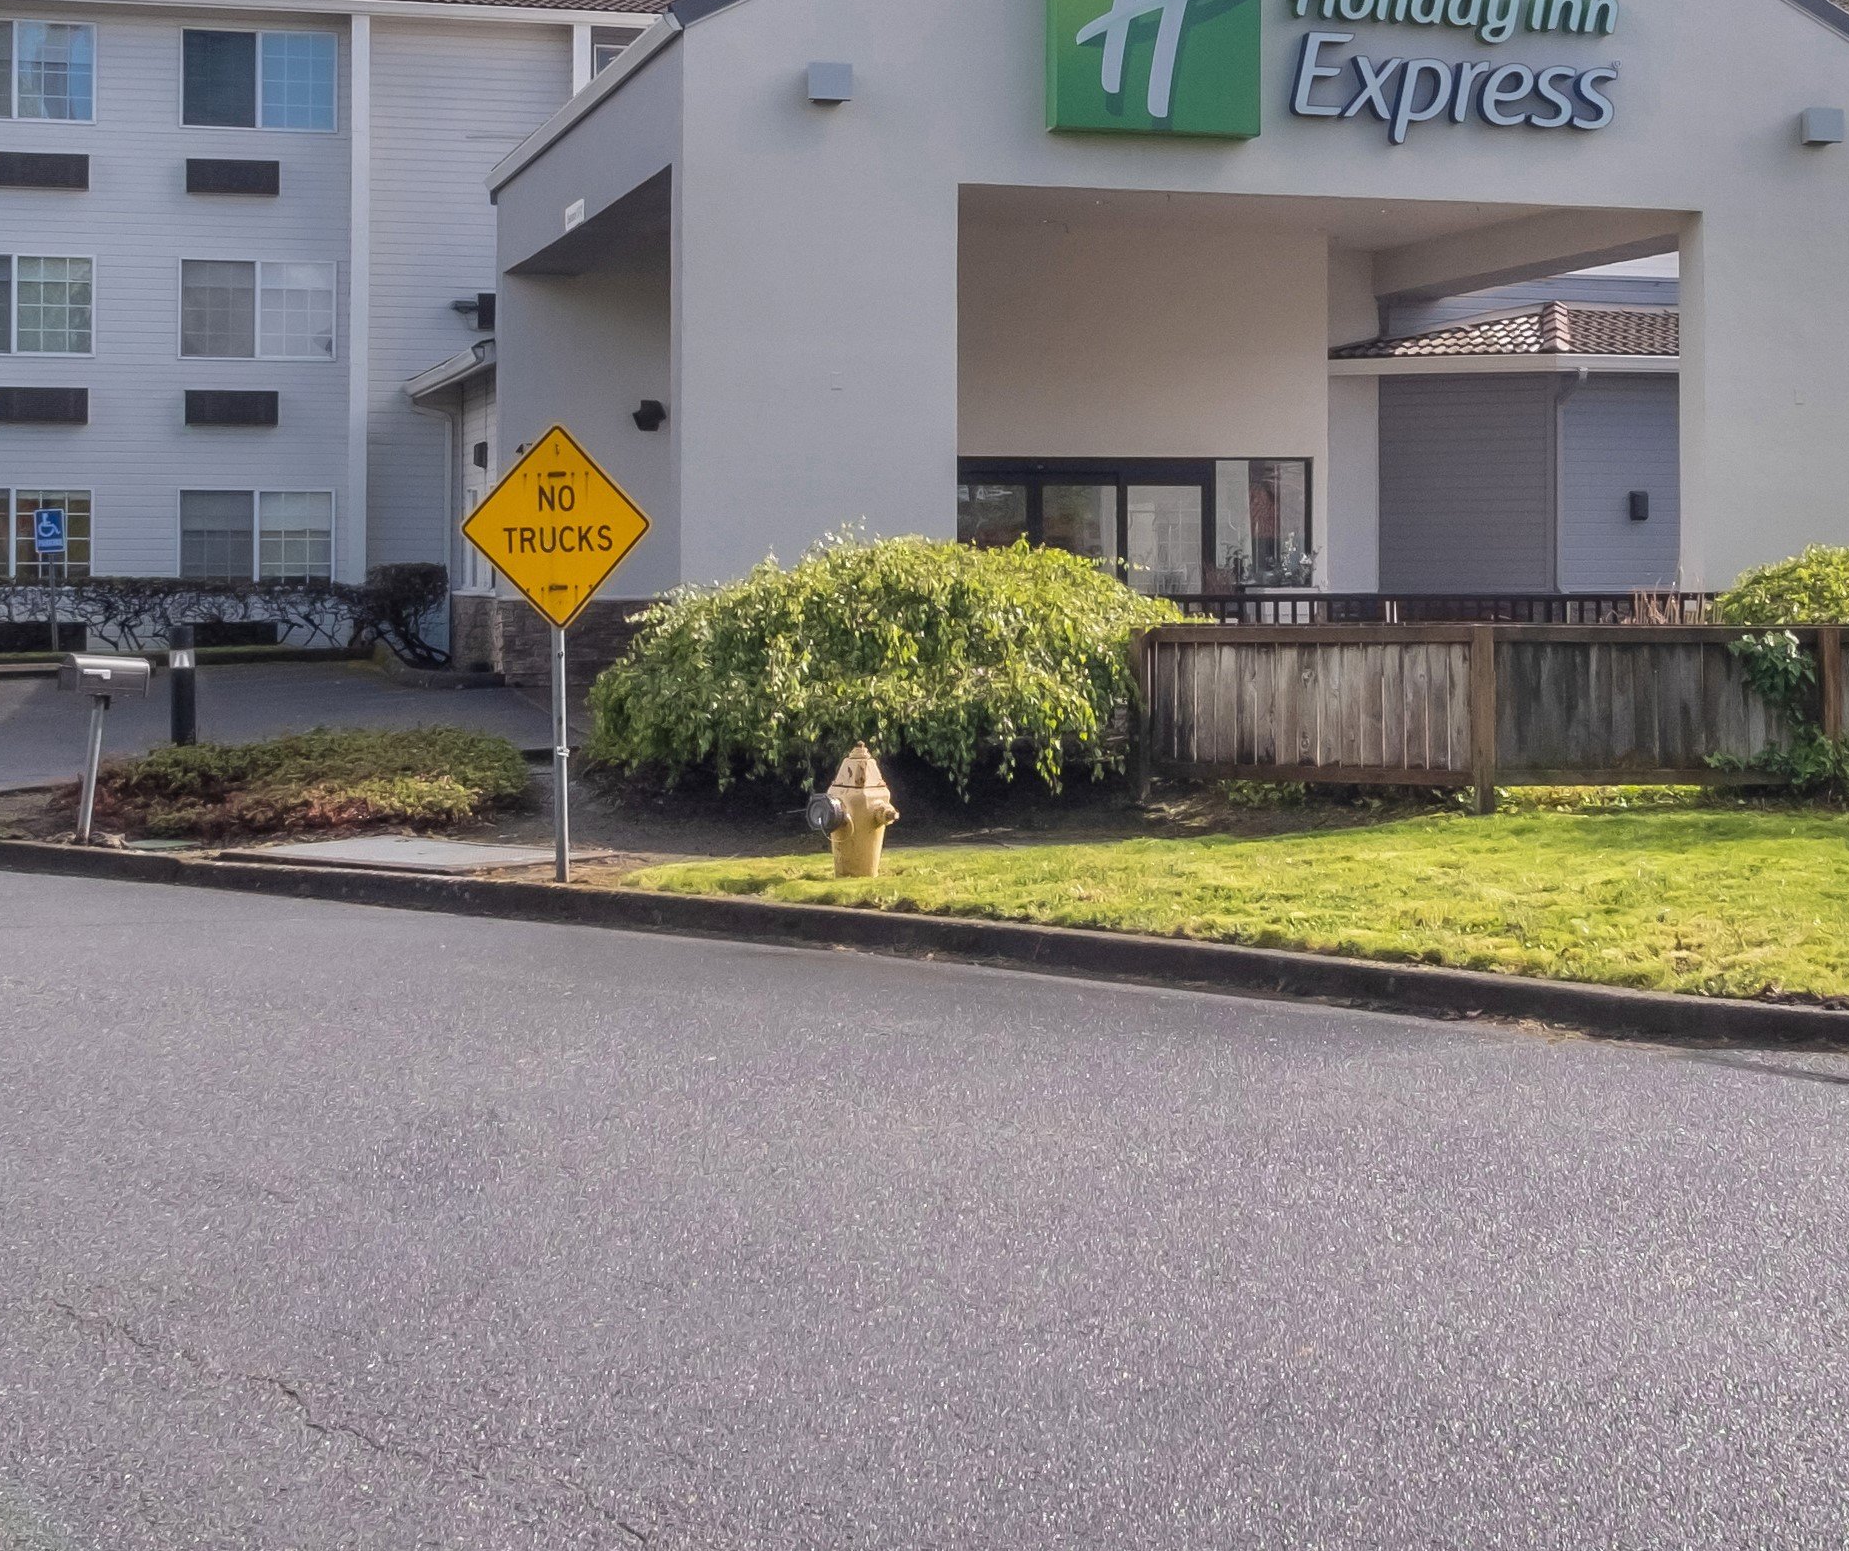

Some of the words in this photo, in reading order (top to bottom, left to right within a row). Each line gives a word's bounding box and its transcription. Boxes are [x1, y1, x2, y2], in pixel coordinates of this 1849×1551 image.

[1289, 31, 1618, 146] Express
[538, 484, 575, 512] NO
[503, 525, 613, 554] TRUCKS
